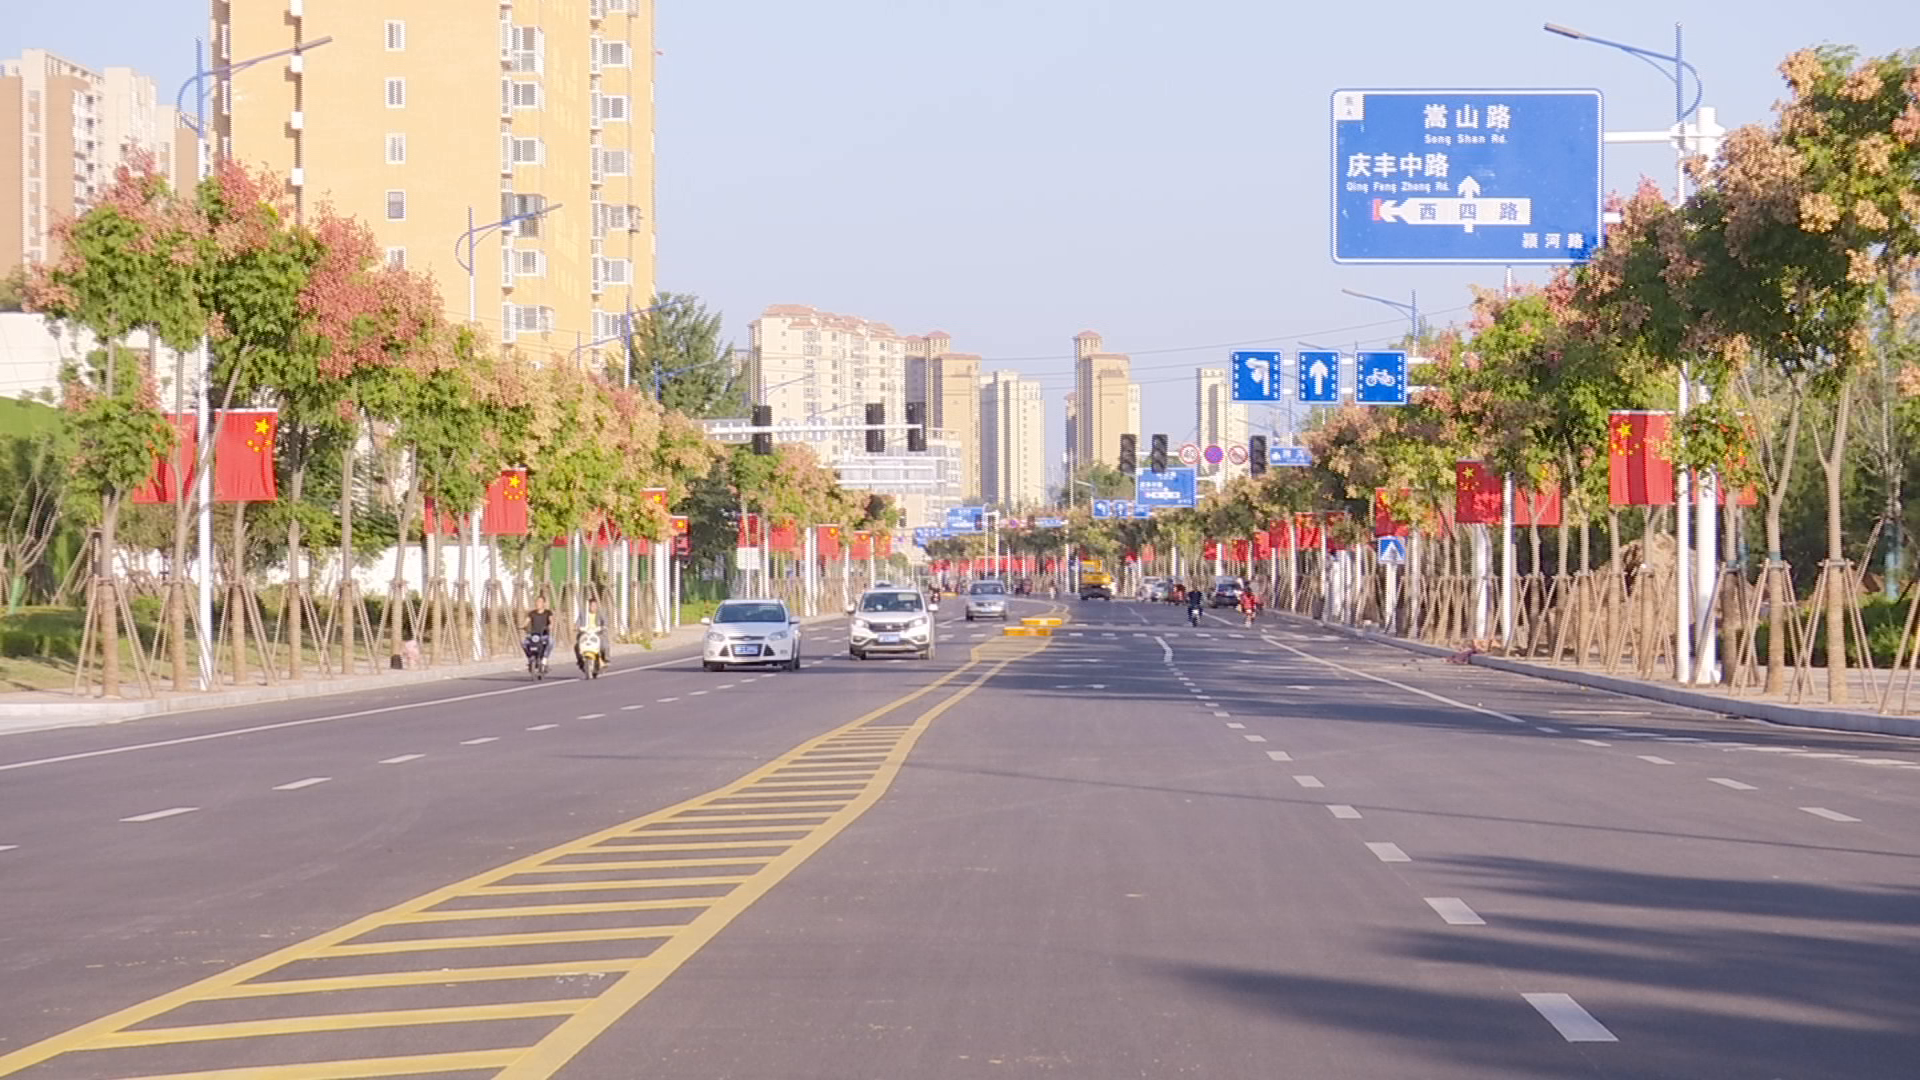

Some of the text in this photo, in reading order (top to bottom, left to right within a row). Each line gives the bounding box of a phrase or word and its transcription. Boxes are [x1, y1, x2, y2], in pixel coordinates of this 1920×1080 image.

[1423, 103, 1512, 130] 嵩山路
[1424, 133, 1453, 147] Song
[1457, 133, 1486, 144] Shan
[1346, 153, 1450, 178] 庆丰中路
[1346, 181, 1369, 194] Qing
[1373, 181, 1398, 194] Feng
[1401, 181, 1432, 194] Zhong
[1418, 202, 1519, 221] 西四路
